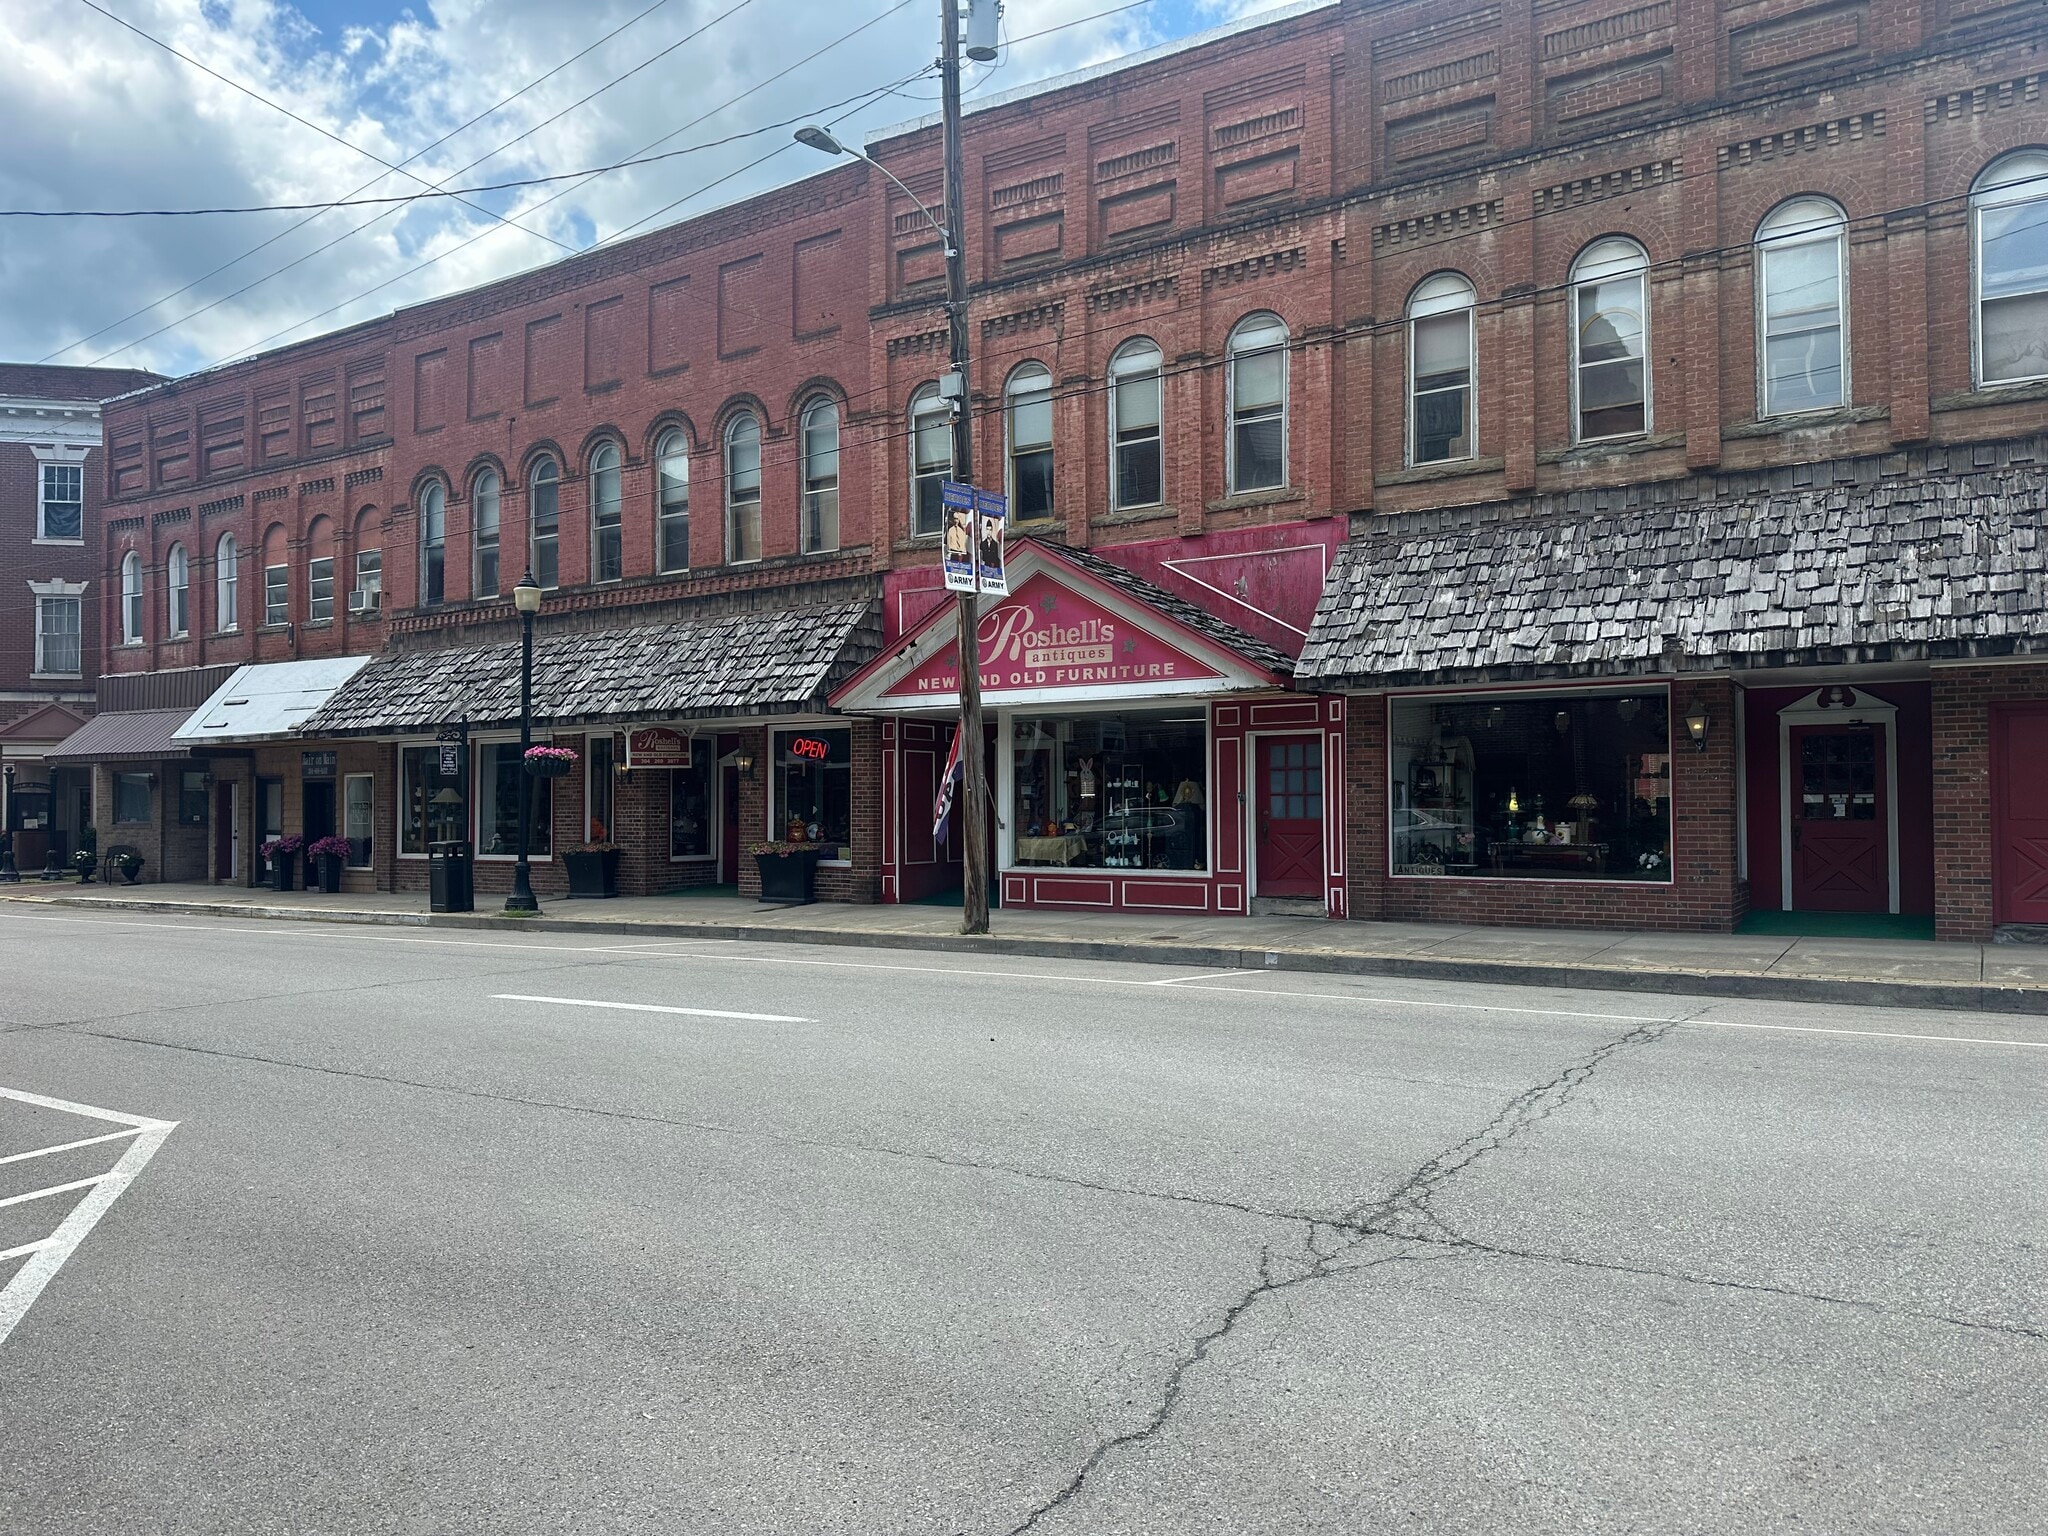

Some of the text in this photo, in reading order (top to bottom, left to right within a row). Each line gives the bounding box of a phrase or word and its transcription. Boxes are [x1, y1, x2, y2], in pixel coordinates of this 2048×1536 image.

[953, 576, 973, 586] ARMY
[987, 580, 1004, 590] ARMY
[977, 604, 1115, 666] Roshell's
[1031, 648, 1106, 665] antiques
[918, 676, 956, 691] NEW
[1009, 670, 1046, 685] OLD
[1056, 662, 1176, 683] FURNITURE
[638, 729, 681, 749] Roshell's
[793, 738, 827, 760] OPEN
[1398, 865, 1442, 874] ANTIQUES
